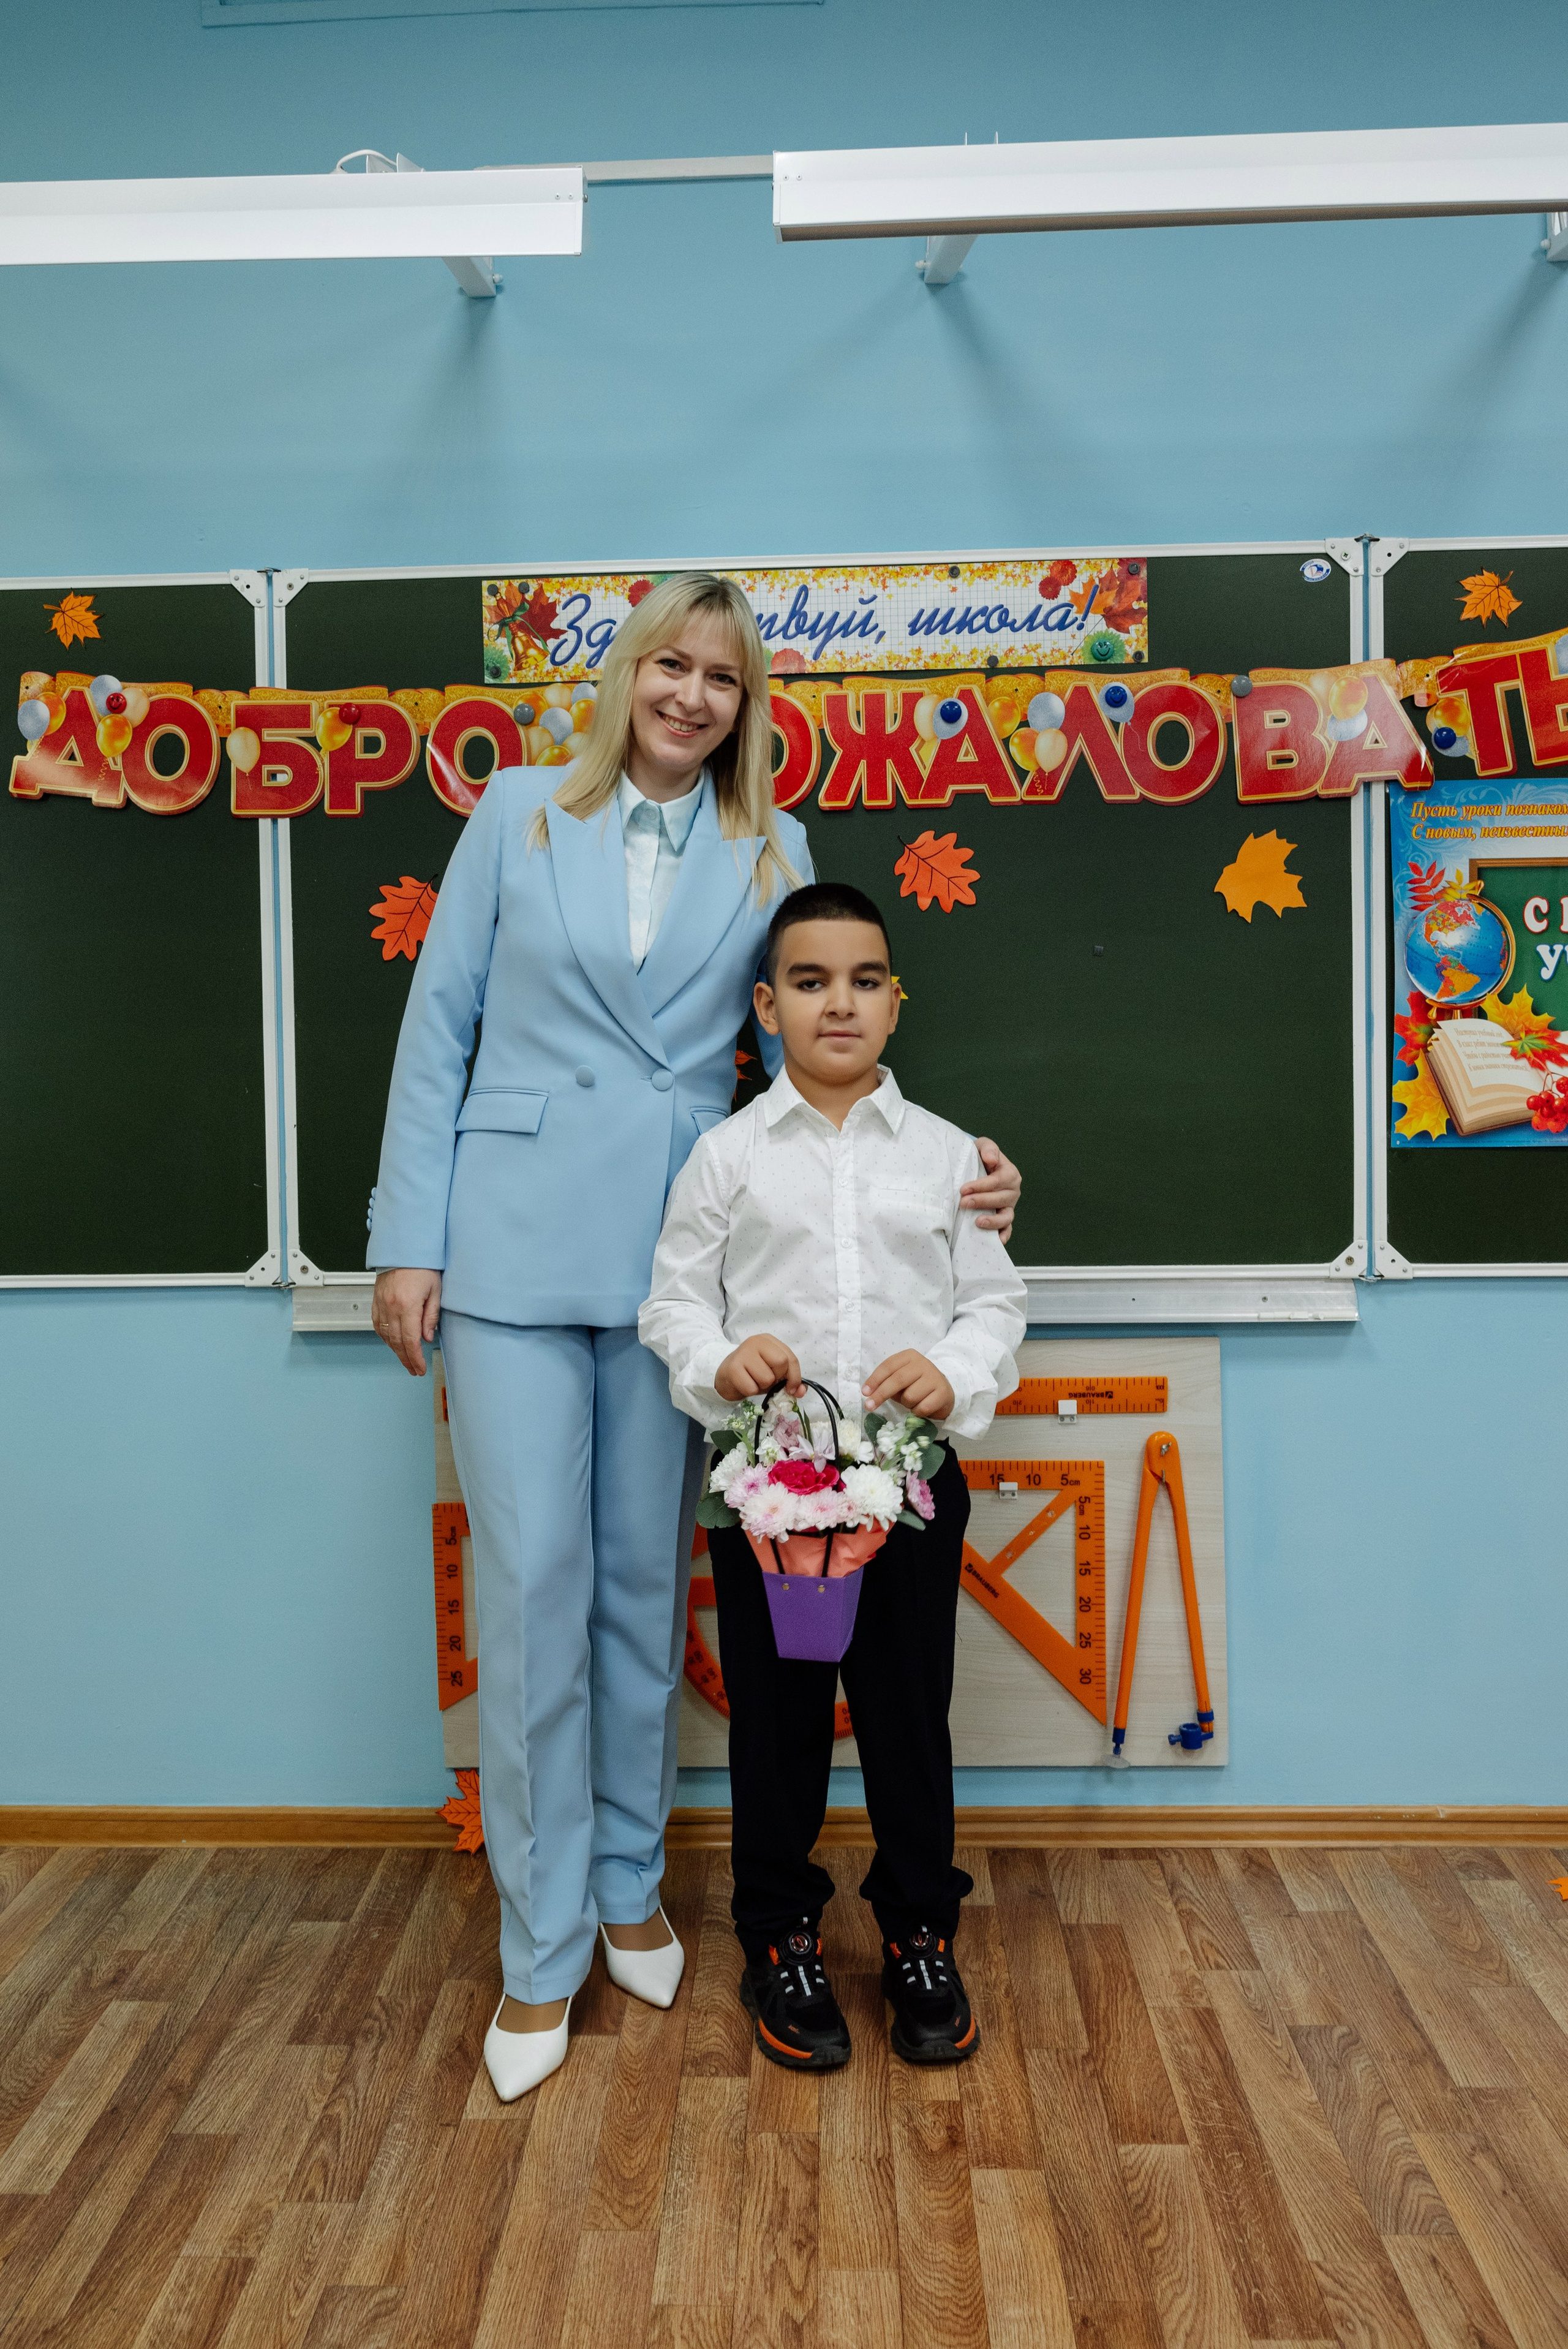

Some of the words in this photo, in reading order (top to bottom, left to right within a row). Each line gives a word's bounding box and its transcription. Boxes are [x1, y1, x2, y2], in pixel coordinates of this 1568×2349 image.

[550, 584, 886, 669] Здтвуй,
[908, 584, 1099, 636] школа!
[9, 686, 532, 819] ДОБРО
[771, 643, 1568, 811] ЖАЛОВАТЬ
[1411, 801, 1458, 821] Пусть
[1460, 804, 1502, 820] уроки
[1411, 823, 1423, 839] С
[1425, 827, 1477, 841] новым,
[1536, 943, 1568, 981] У
[989, 1473, 1005, 1485] 15
[1026, 1473, 1041, 1486] 10
[1061, 1473, 1080, 1486] 5cm
[1079, 1496, 1091, 1516] 5cm
[1079, 1524, 1091, 1540] 10
[447, 1564, 458, 1579] 10
[1079, 1560, 1091, 1576] 15
[972, 1570, 1000, 1598] BRAUBERG
[448, 1599, 459, 1615] 15
[1079, 1596, 1091, 1613] 20
[450, 1635, 461, 1652] 20
[1079, 1632, 1091, 1649] 25
[451, 1670, 462, 1687] 25
[1079, 1668, 1091, 1685] 30
